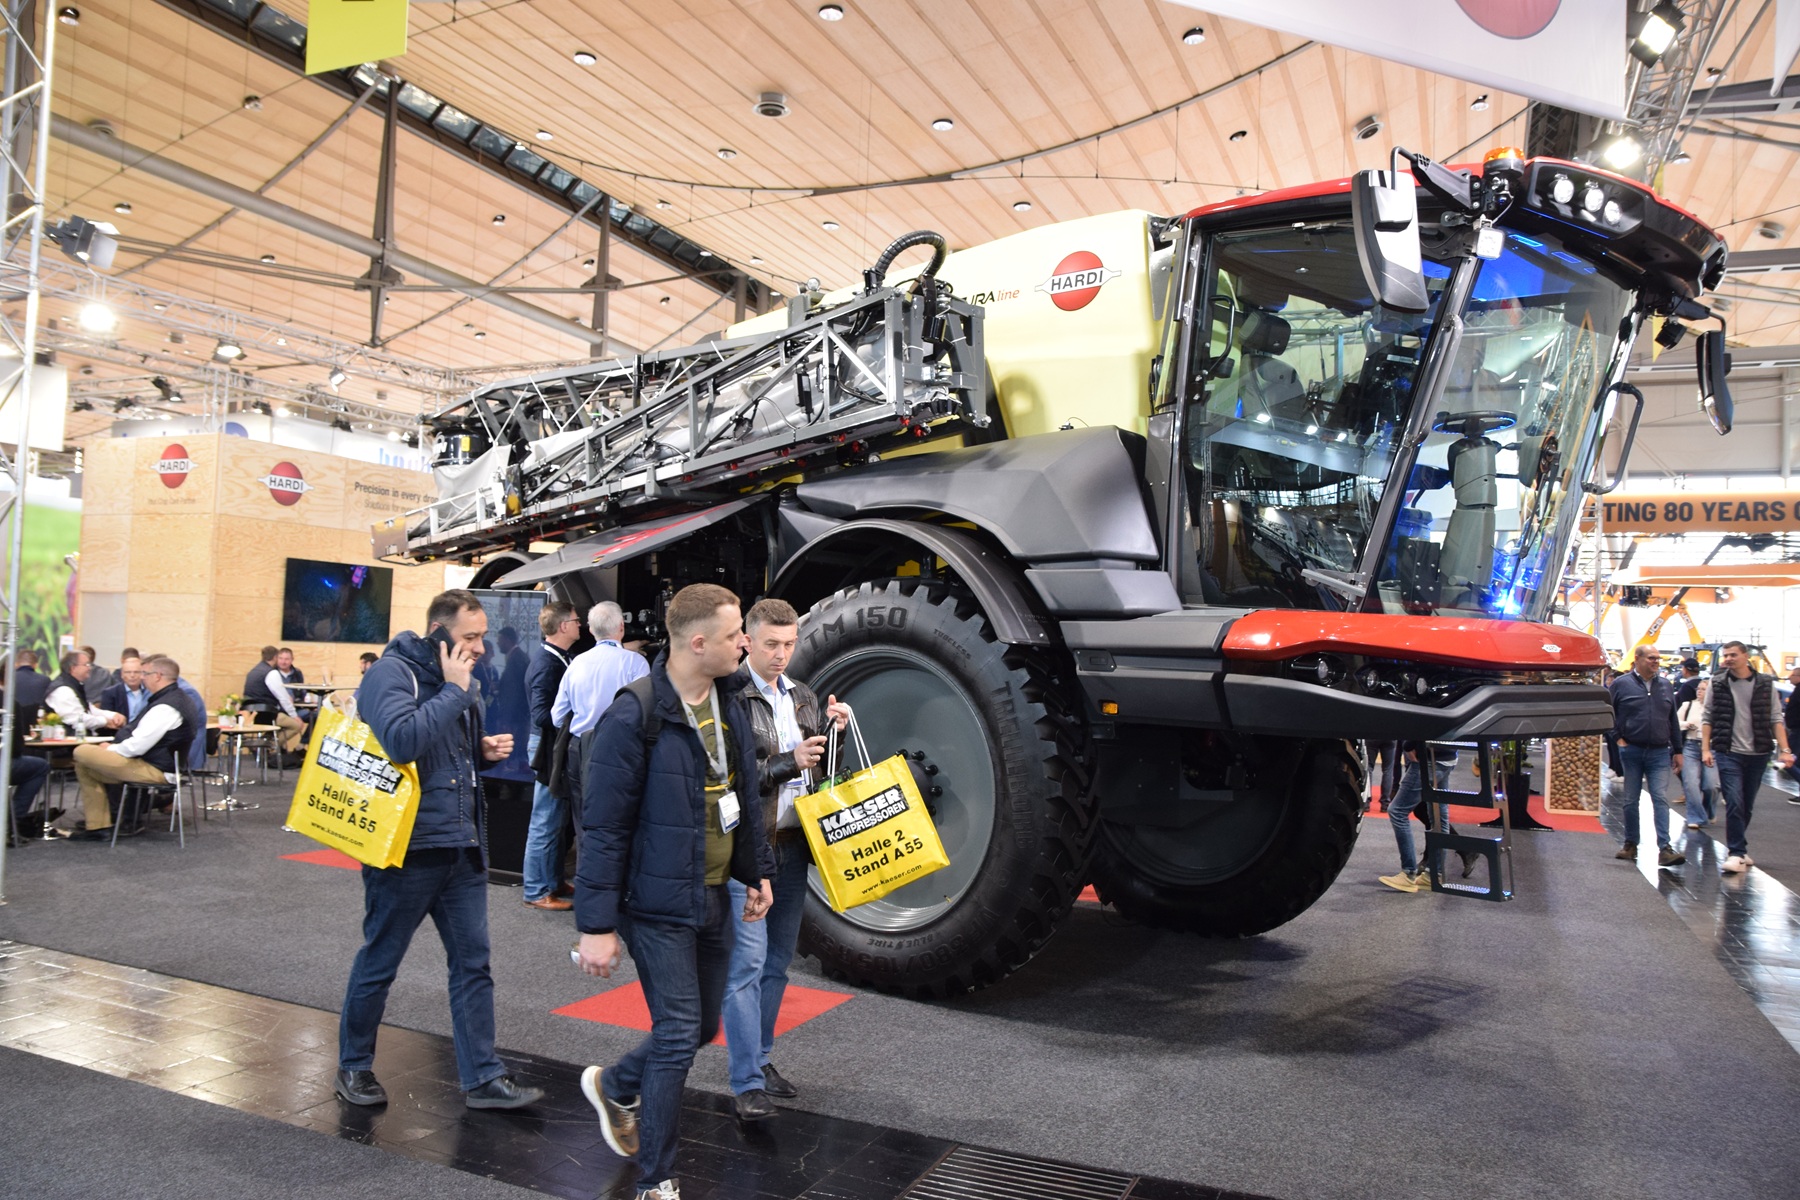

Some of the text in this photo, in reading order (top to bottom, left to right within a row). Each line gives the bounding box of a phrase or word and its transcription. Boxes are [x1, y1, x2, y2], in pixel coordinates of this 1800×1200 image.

[1051, 270, 1103, 291] HARDI
[159, 461, 189, 471] HARDI
[269, 477, 304, 491] HARDI
[354, 481, 390, 496] Precision
[392, 487, 400, 498] in
[401, 491, 421, 504] every
[1664, 502, 1693, 522] 80
[1702, 501, 1786, 522] YEARS
[804, 606, 909, 651] TM 150
[1648, 617, 1663, 636] JCB
[1681, 613, 1694, 629] JCB
[318, 754, 396, 792] KOMPRESSOREN
[321, 740, 401, 782] KAESER
[992, 680, 1036, 849] TRELLEBORG
[307, 794, 345, 820] Stand
[322, 783, 369, 812] Halle 2
[822, 788, 900, 832] KAESER
[311, 822, 364, 847] www.kaeser.com
[827, 801, 906, 843] KOMPRESSOREN
[851, 829, 905, 861] Halle 2
[844, 854, 889, 881] Stand
[862, 864, 922, 894] www.kaeser.com
